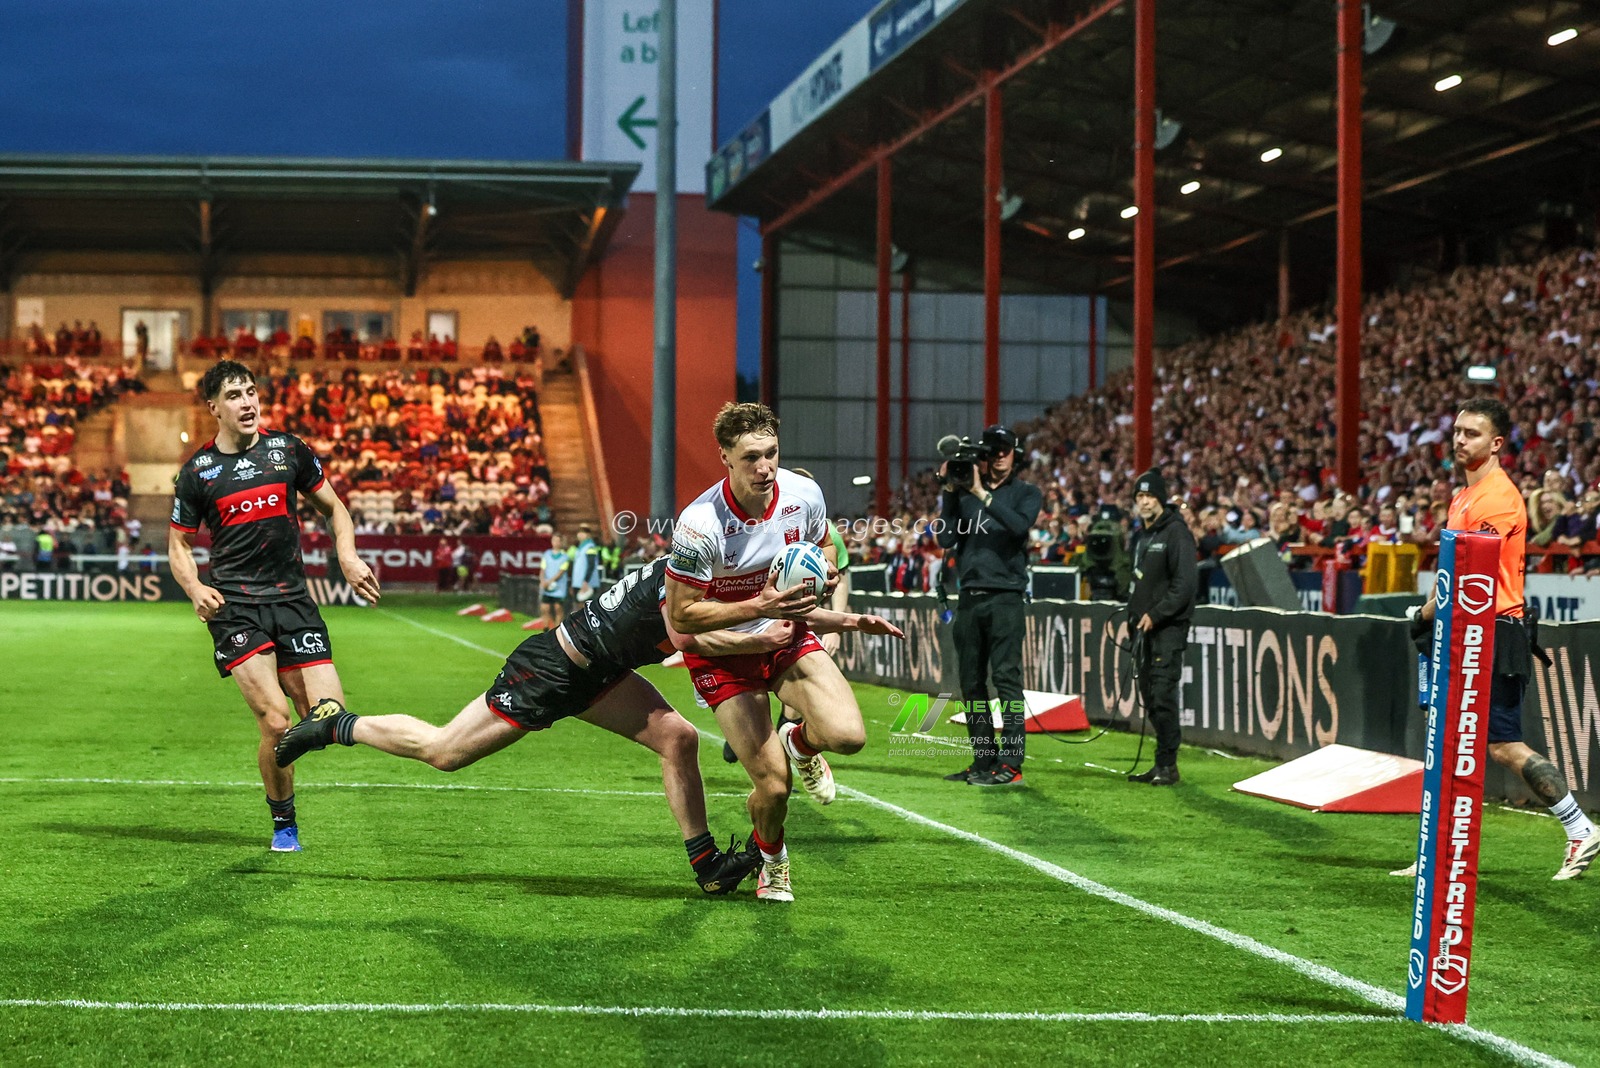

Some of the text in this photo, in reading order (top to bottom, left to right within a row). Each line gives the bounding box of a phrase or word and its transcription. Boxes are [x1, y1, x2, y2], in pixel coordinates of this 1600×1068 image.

[622, 10, 660, 33] Lef
[641, 41, 658, 64] b
[228, 494, 279, 514] tote
[1425, 618, 1443, 771] BETFRED
[1454, 624, 1484, 777] BETFRED
[1413, 790, 1432, 941] BETFRED
[1444, 796, 1473, 946] BETFRED
